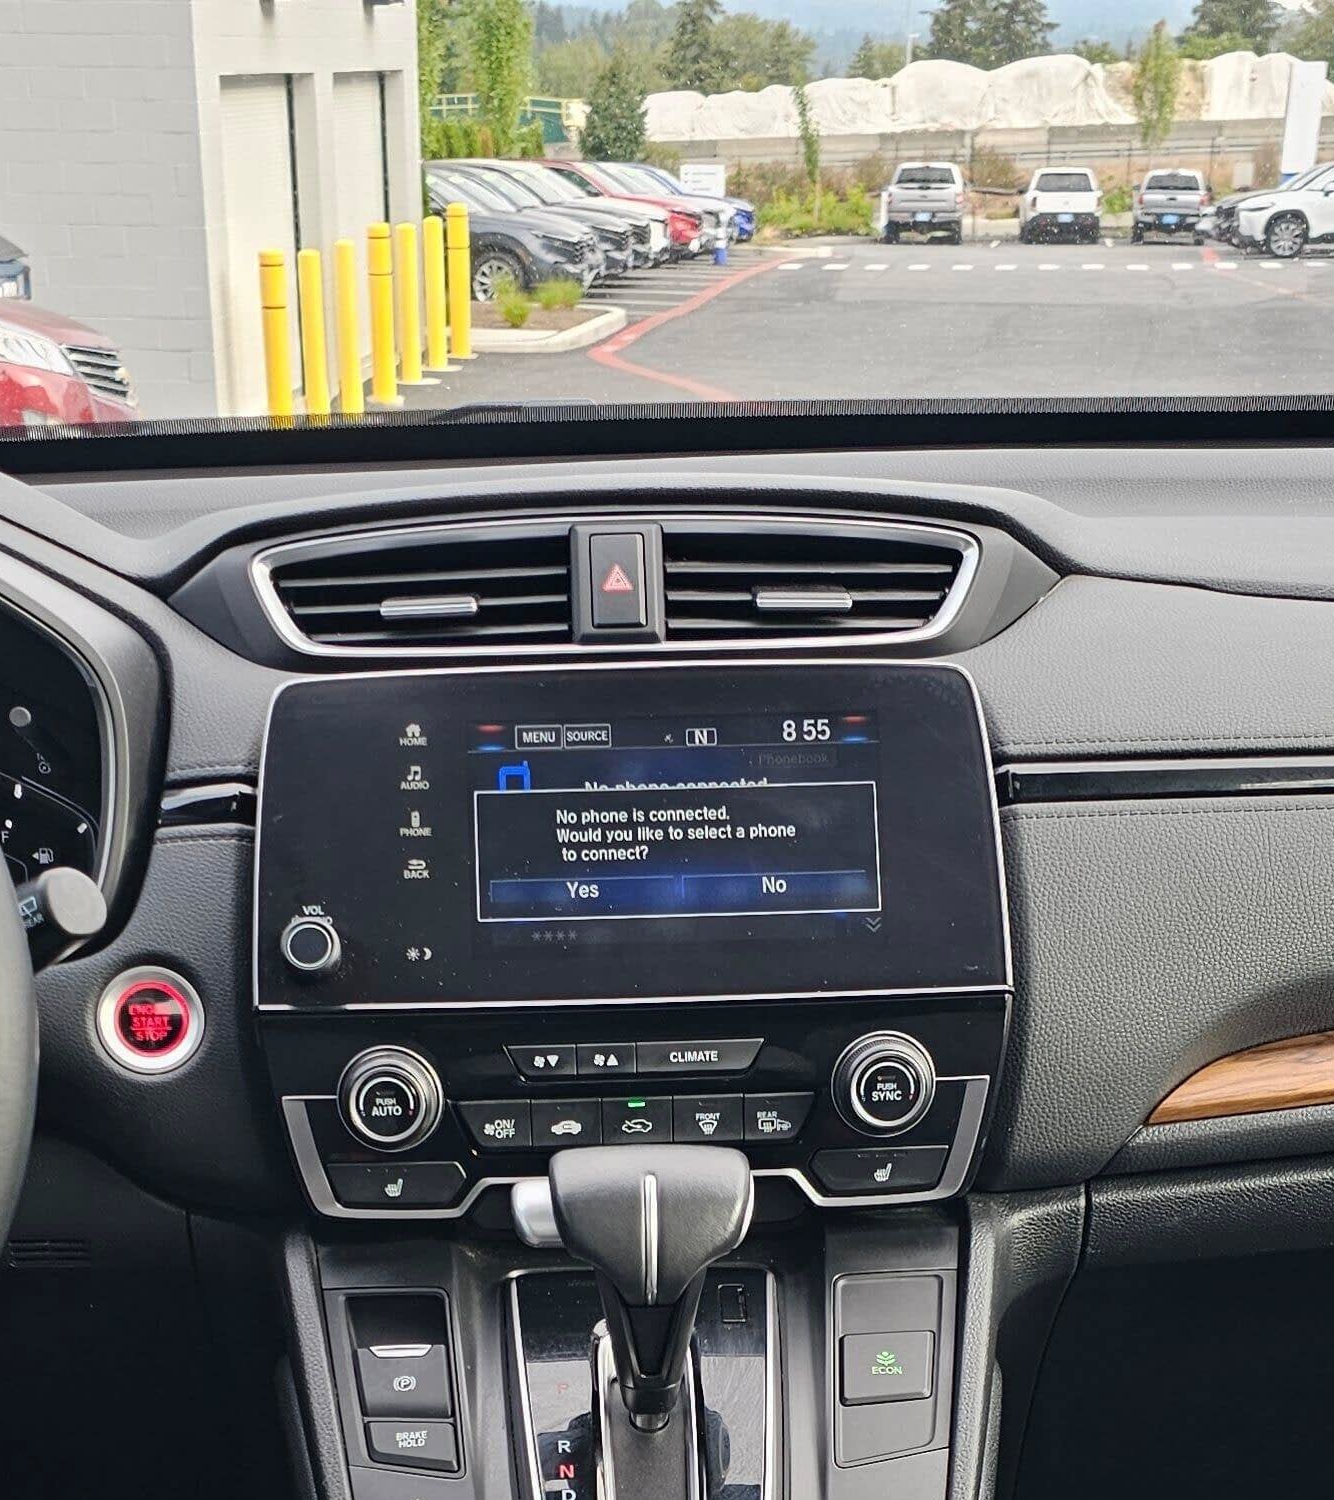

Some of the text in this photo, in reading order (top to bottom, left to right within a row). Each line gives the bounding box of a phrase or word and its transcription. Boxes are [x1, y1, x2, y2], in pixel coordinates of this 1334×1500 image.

[399, 737, 428, 746] HOME
[522, 731, 556, 743] MENU
[566, 730, 608, 742] SOURCE
[400, 781, 430, 790] AUDIO
[556, 805, 730, 825] No phone is connected.
[1, 830, 9, 843] F
[399, 827, 432, 837] PHONE
[557, 822, 796, 844] Would you like to select a phone
[562, 845, 649, 862] to connect?
[403, 869, 430, 879] BACK
[566, 881, 600, 898] Yes
[762, 876, 787, 894] No
[302, 905, 325, 915] VOL
[131, 1016, 170, 1028] START
[135, 1030, 168, 1041] STOP
[669, 1050, 718, 1063] CLIMATE
[871, 1090, 902, 1101] SYNC
[371, 1105, 402, 1117] AUTO
[695, 1112, 720, 1121] FRONT
[756, 1111, 778, 1119] REAR
[494, 1119, 515, 1130] ON/
[495, 1127, 516, 1139] OFF
[871, 1366, 903, 1375] ECON
[395, 1431, 428, 1441] BRAKE
[398, 1439, 426, 1449] HOLD
[557, 1440, 572, 1454] R
[559, 1464, 575, 1479] N
